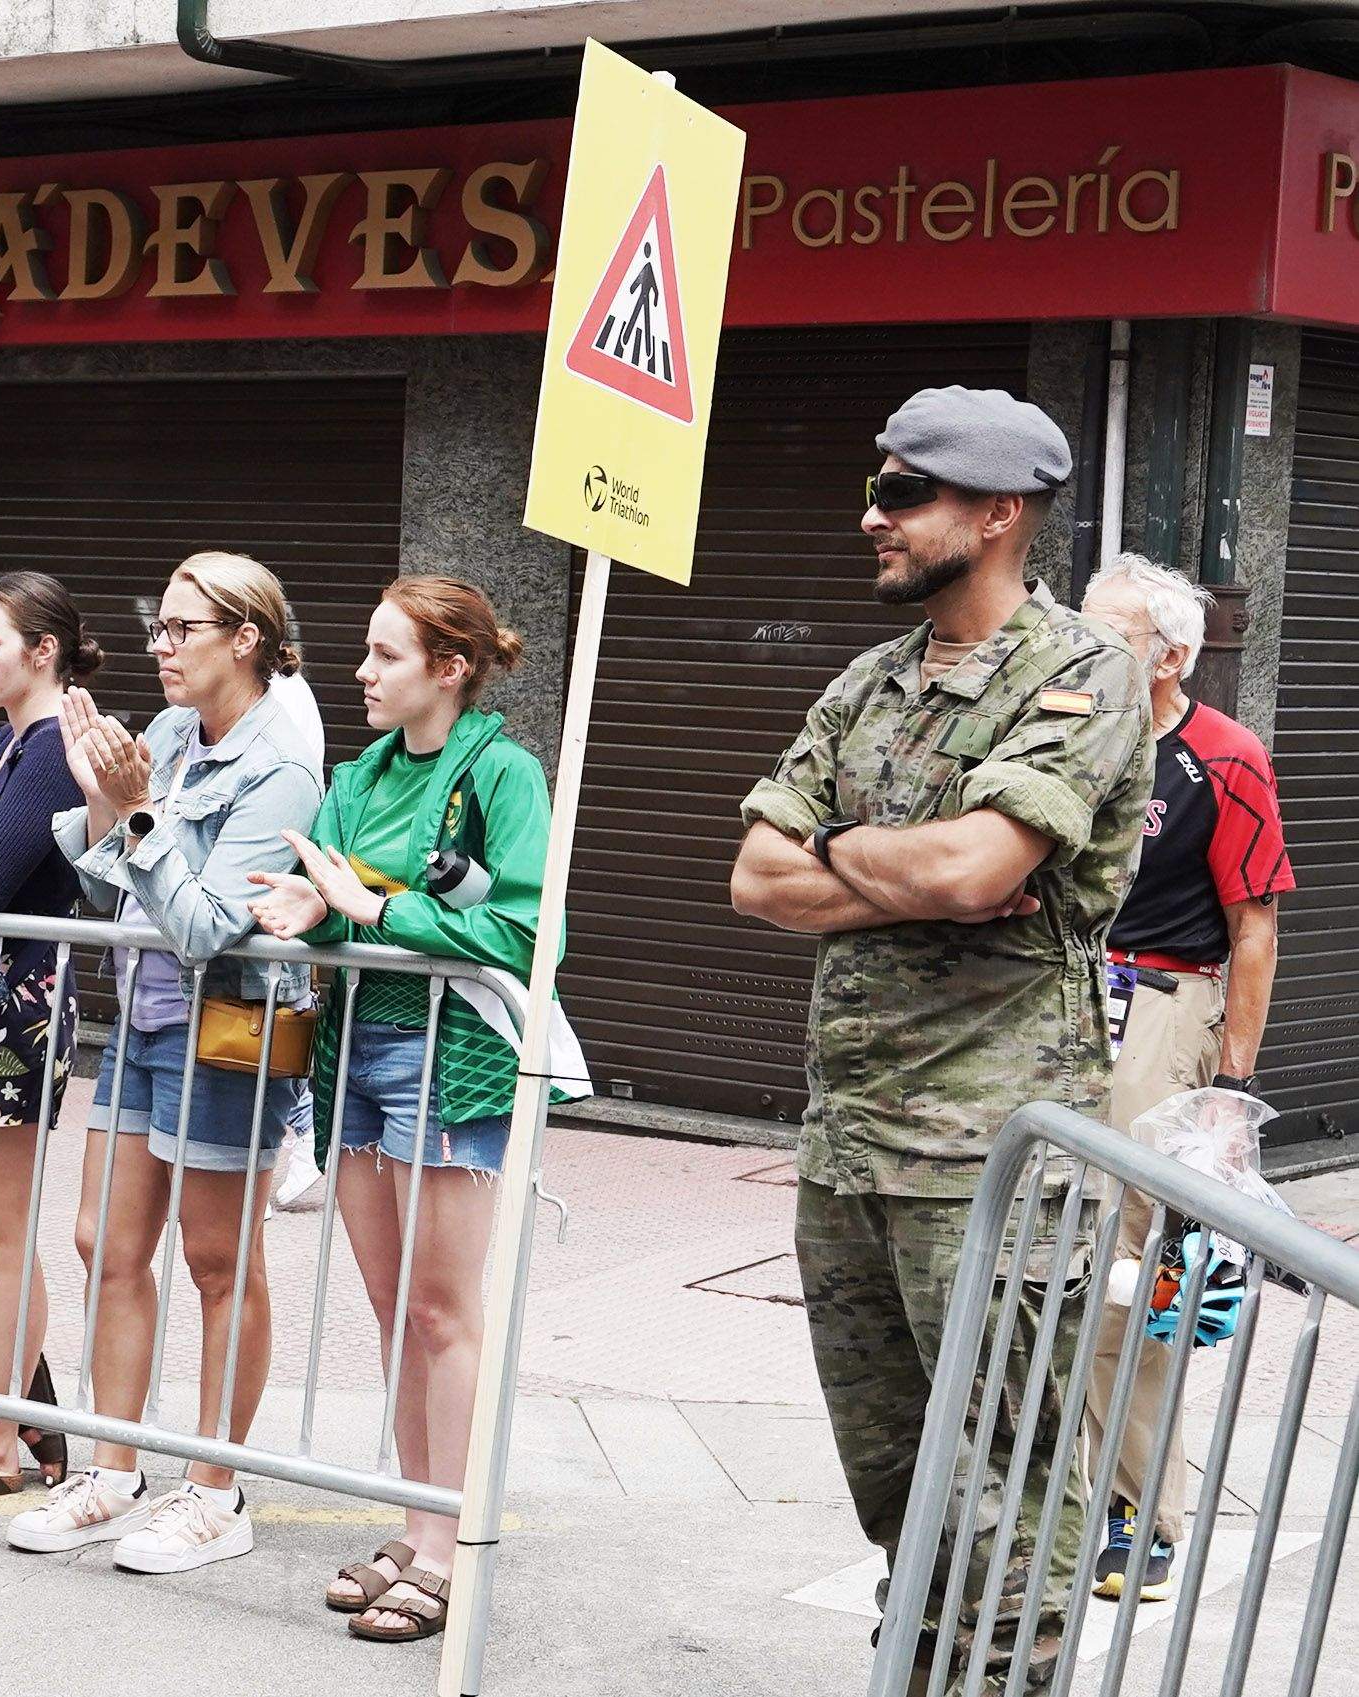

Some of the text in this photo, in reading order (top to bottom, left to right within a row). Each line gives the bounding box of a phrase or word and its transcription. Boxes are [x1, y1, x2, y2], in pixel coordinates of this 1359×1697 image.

[741, 146, 1181, 249] Pastelería
[611, 476, 640, 503] World
[610, 495, 650, 527] Triathlon
[1174, 750, 1204, 784] 2XU
